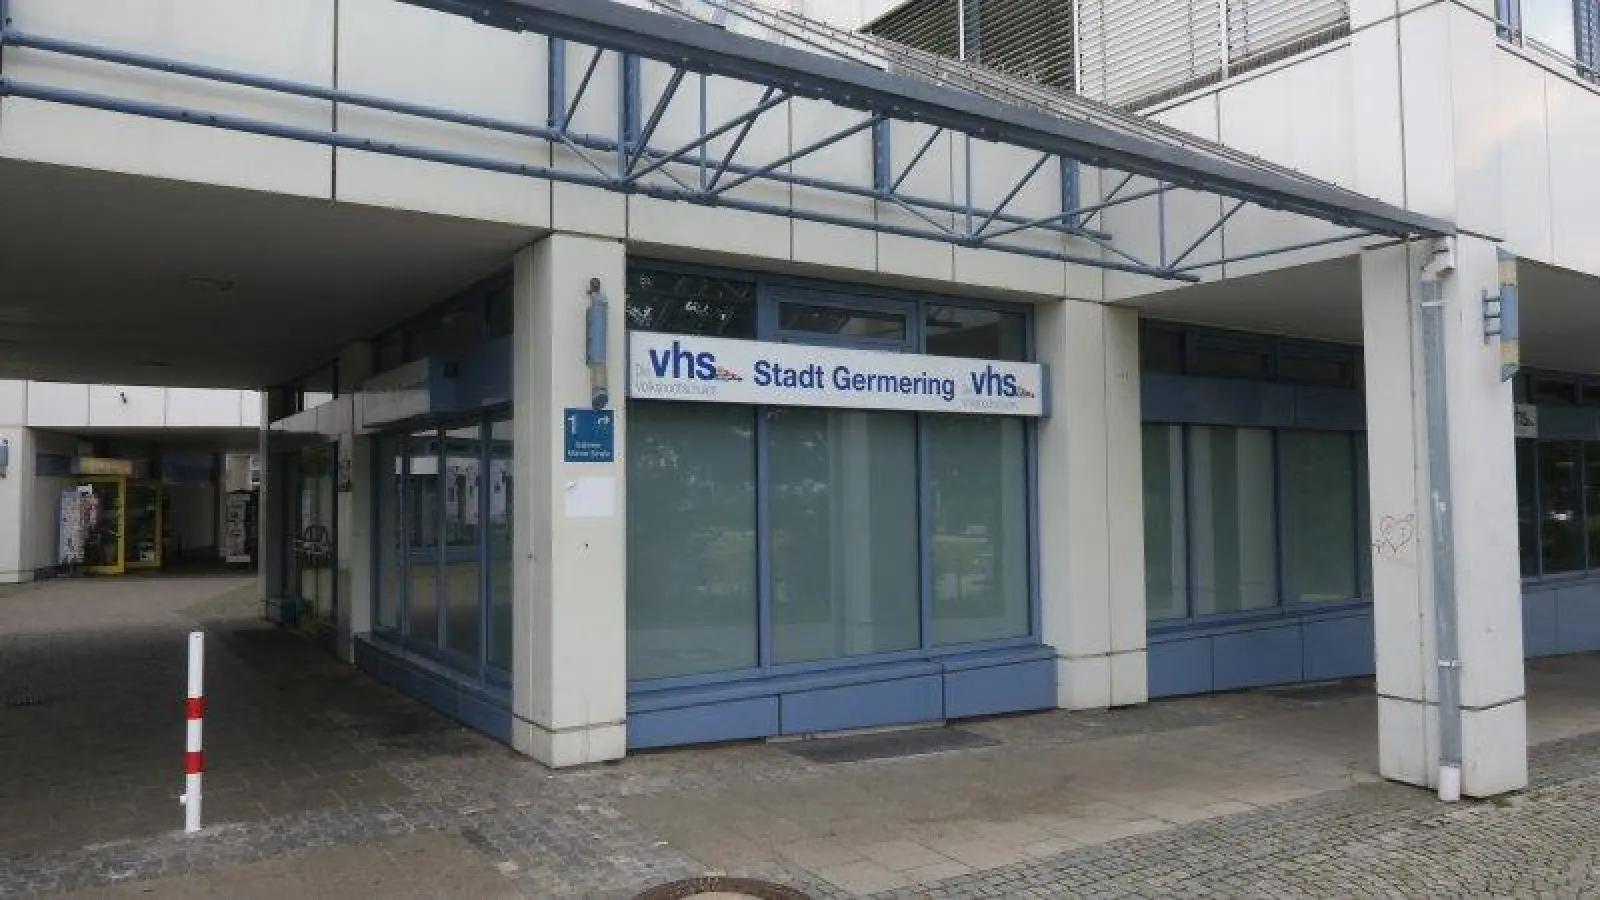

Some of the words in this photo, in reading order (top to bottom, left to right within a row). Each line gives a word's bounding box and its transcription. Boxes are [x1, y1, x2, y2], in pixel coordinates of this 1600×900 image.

[649, 341, 717, 380] vhs
[754, 360, 825, 389] Stadt
[831, 365, 955, 402] Germering
[971, 364, 1017, 397] vhs
[567, 414, 577, 435] 1
